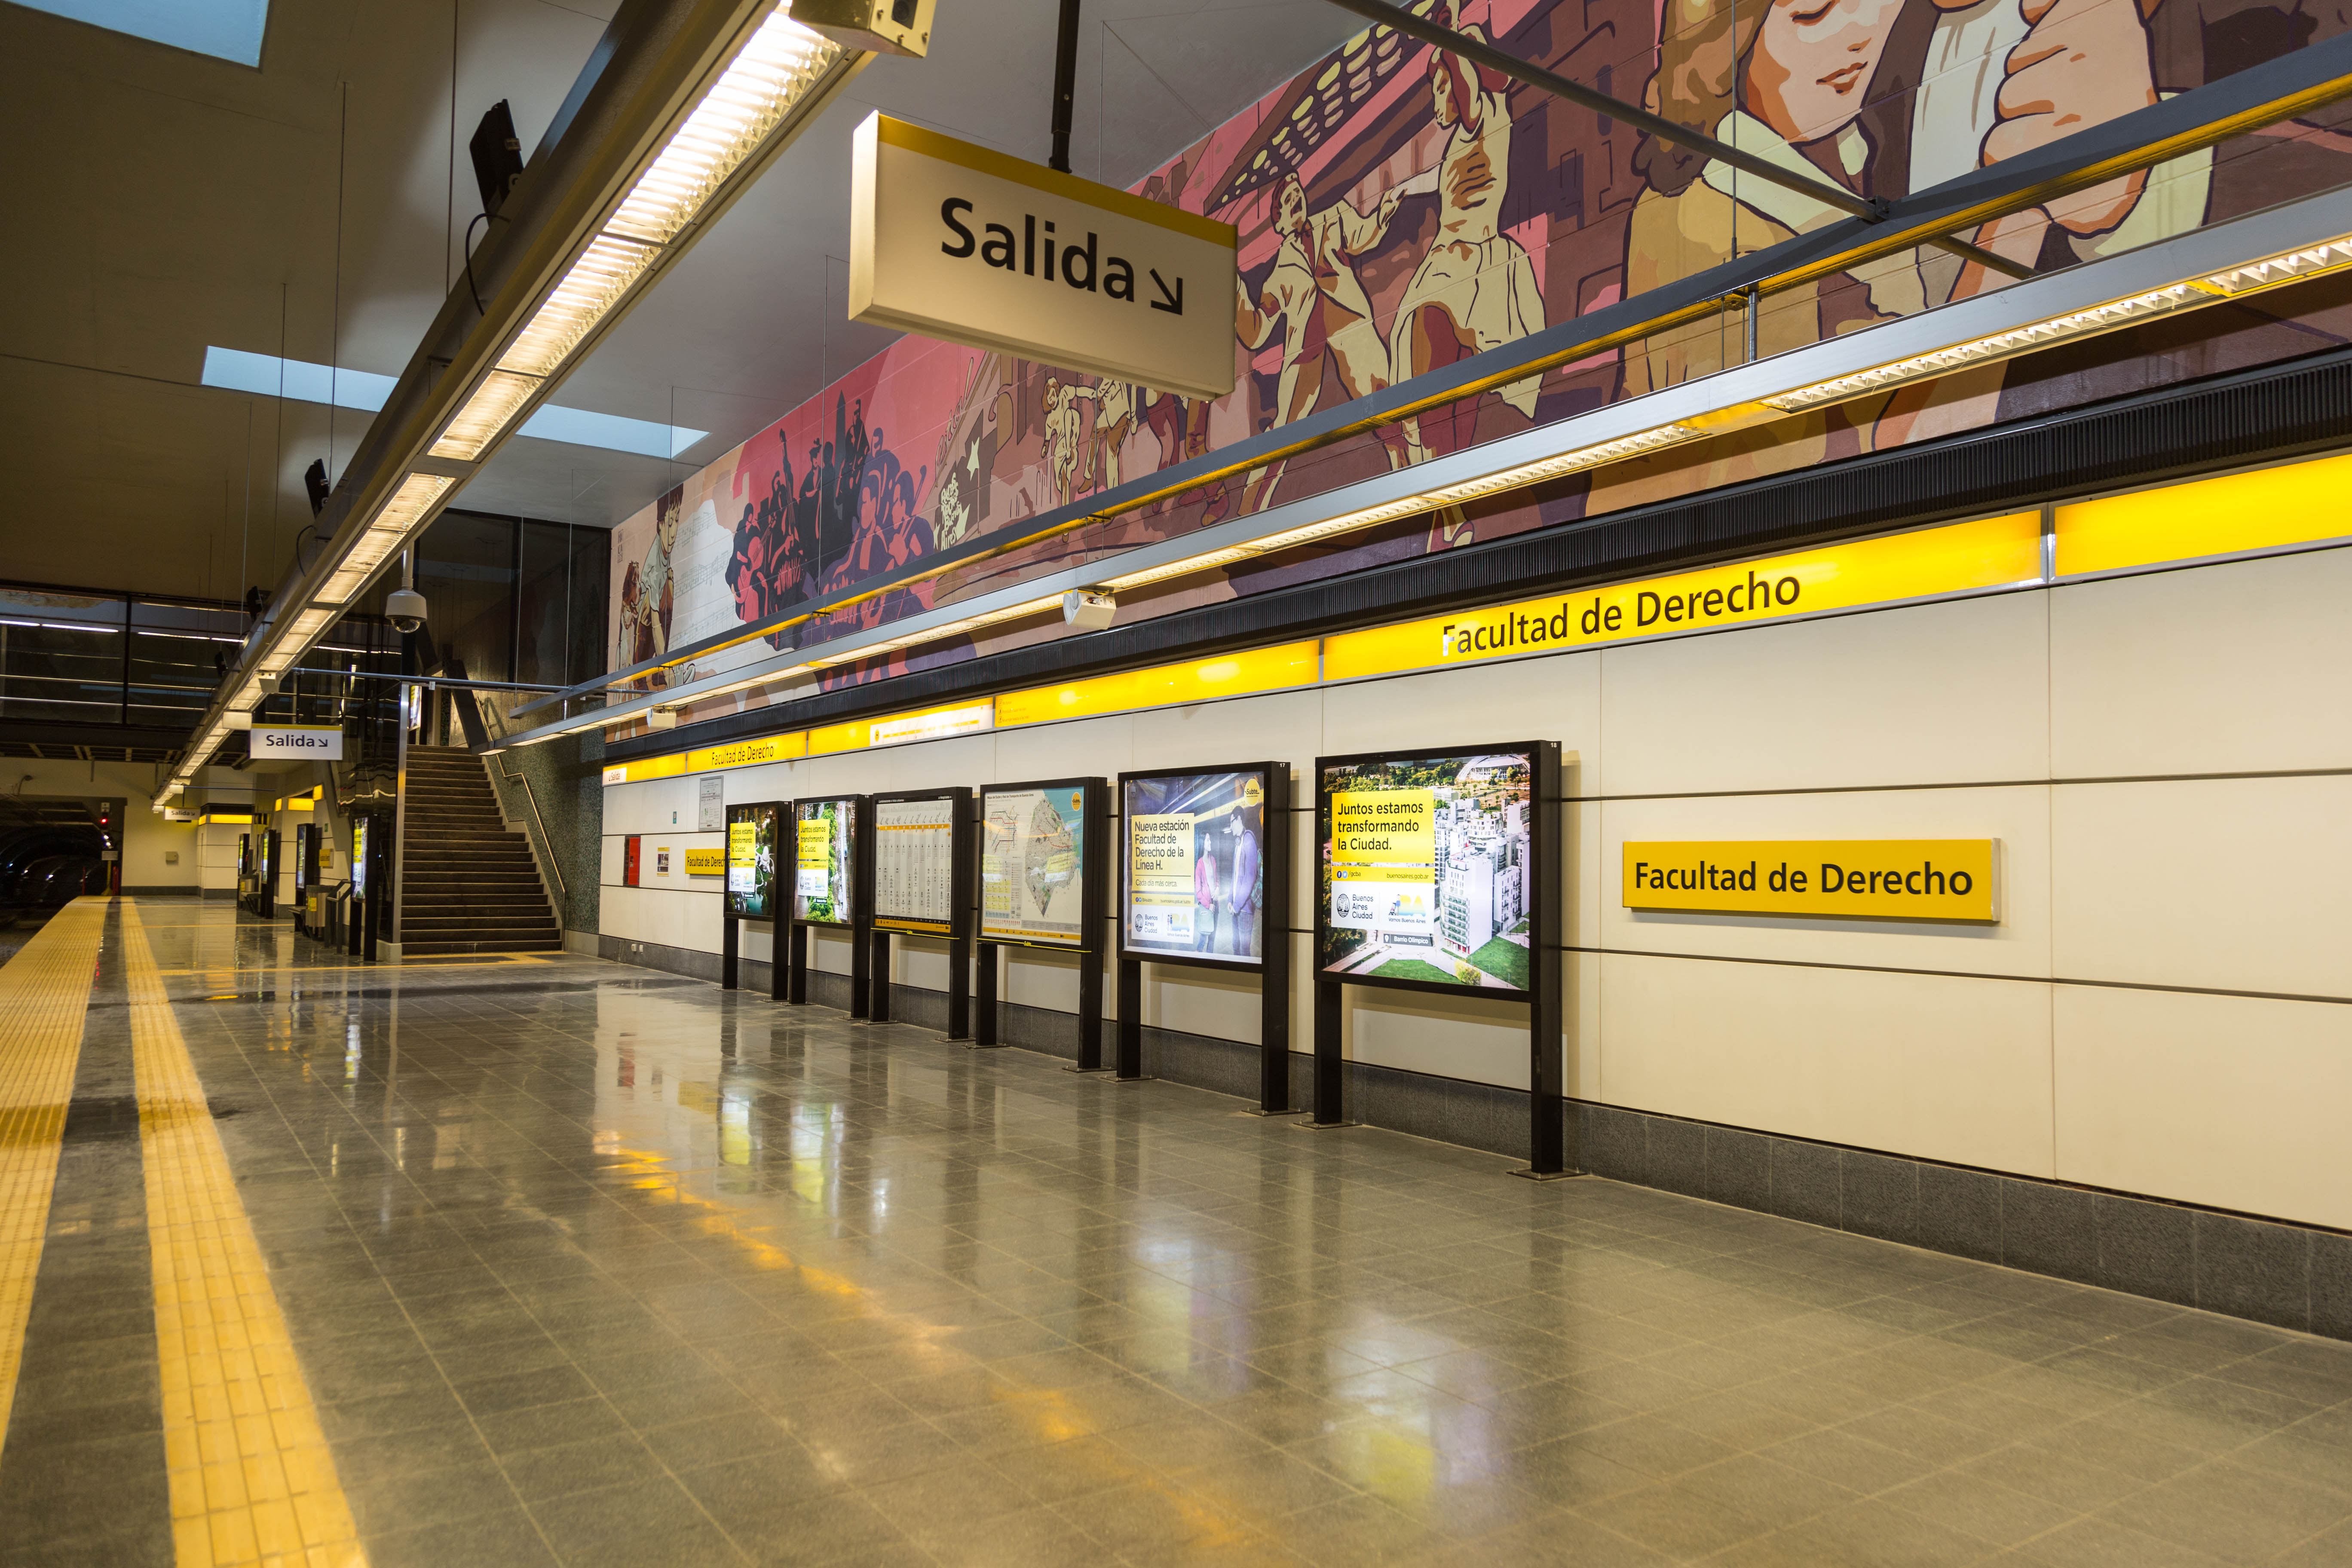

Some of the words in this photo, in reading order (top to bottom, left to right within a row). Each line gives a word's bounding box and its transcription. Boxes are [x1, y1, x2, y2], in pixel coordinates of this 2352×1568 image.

[941, 197, 1135, 303] Salida
[1442, 603, 1568, 657] Facultad
[1581, 597, 1622, 635] de
[1637, 571, 1801, 628] Derecho
[266, 735, 315, 747] Salida
[712, 750, 735, 766] Facultad
[738, 746, 745, 762] de
[747, 742, 774, 760] Derecho
[1338, 803, 1373, 815] Juntos
[1377, 802, 1423, 814] estamos
[1135, 821, 1158, 832] Nueva
[1159, 819, 1189, 831] estación
[1338, 819, 1419, 833] transformando
[1135, 833, 1165, 844] Facultad
[1167, 833, 1176, 844] de
[1338, 838, 1347, 850] la
[1351, 837, 1392, 850] Ciudad.
[1136, 846, 1165, 857] Derecho
[1167, 846, 1176, 857] de
[1178, 846, 1184, 857] la
[687, 856, 704, 867] Facultad
[705, 856, 710, 867] de
[711, 856, 725, 867] Derech
[1136, 859, 1154, 870] Línea
[1156, 860, 1163, 870] H.
[1635, 861, 1756, 892] Facultad
[1769, 862, 1807, 893] de
[1821, 861, 1973, 895] Derecho
